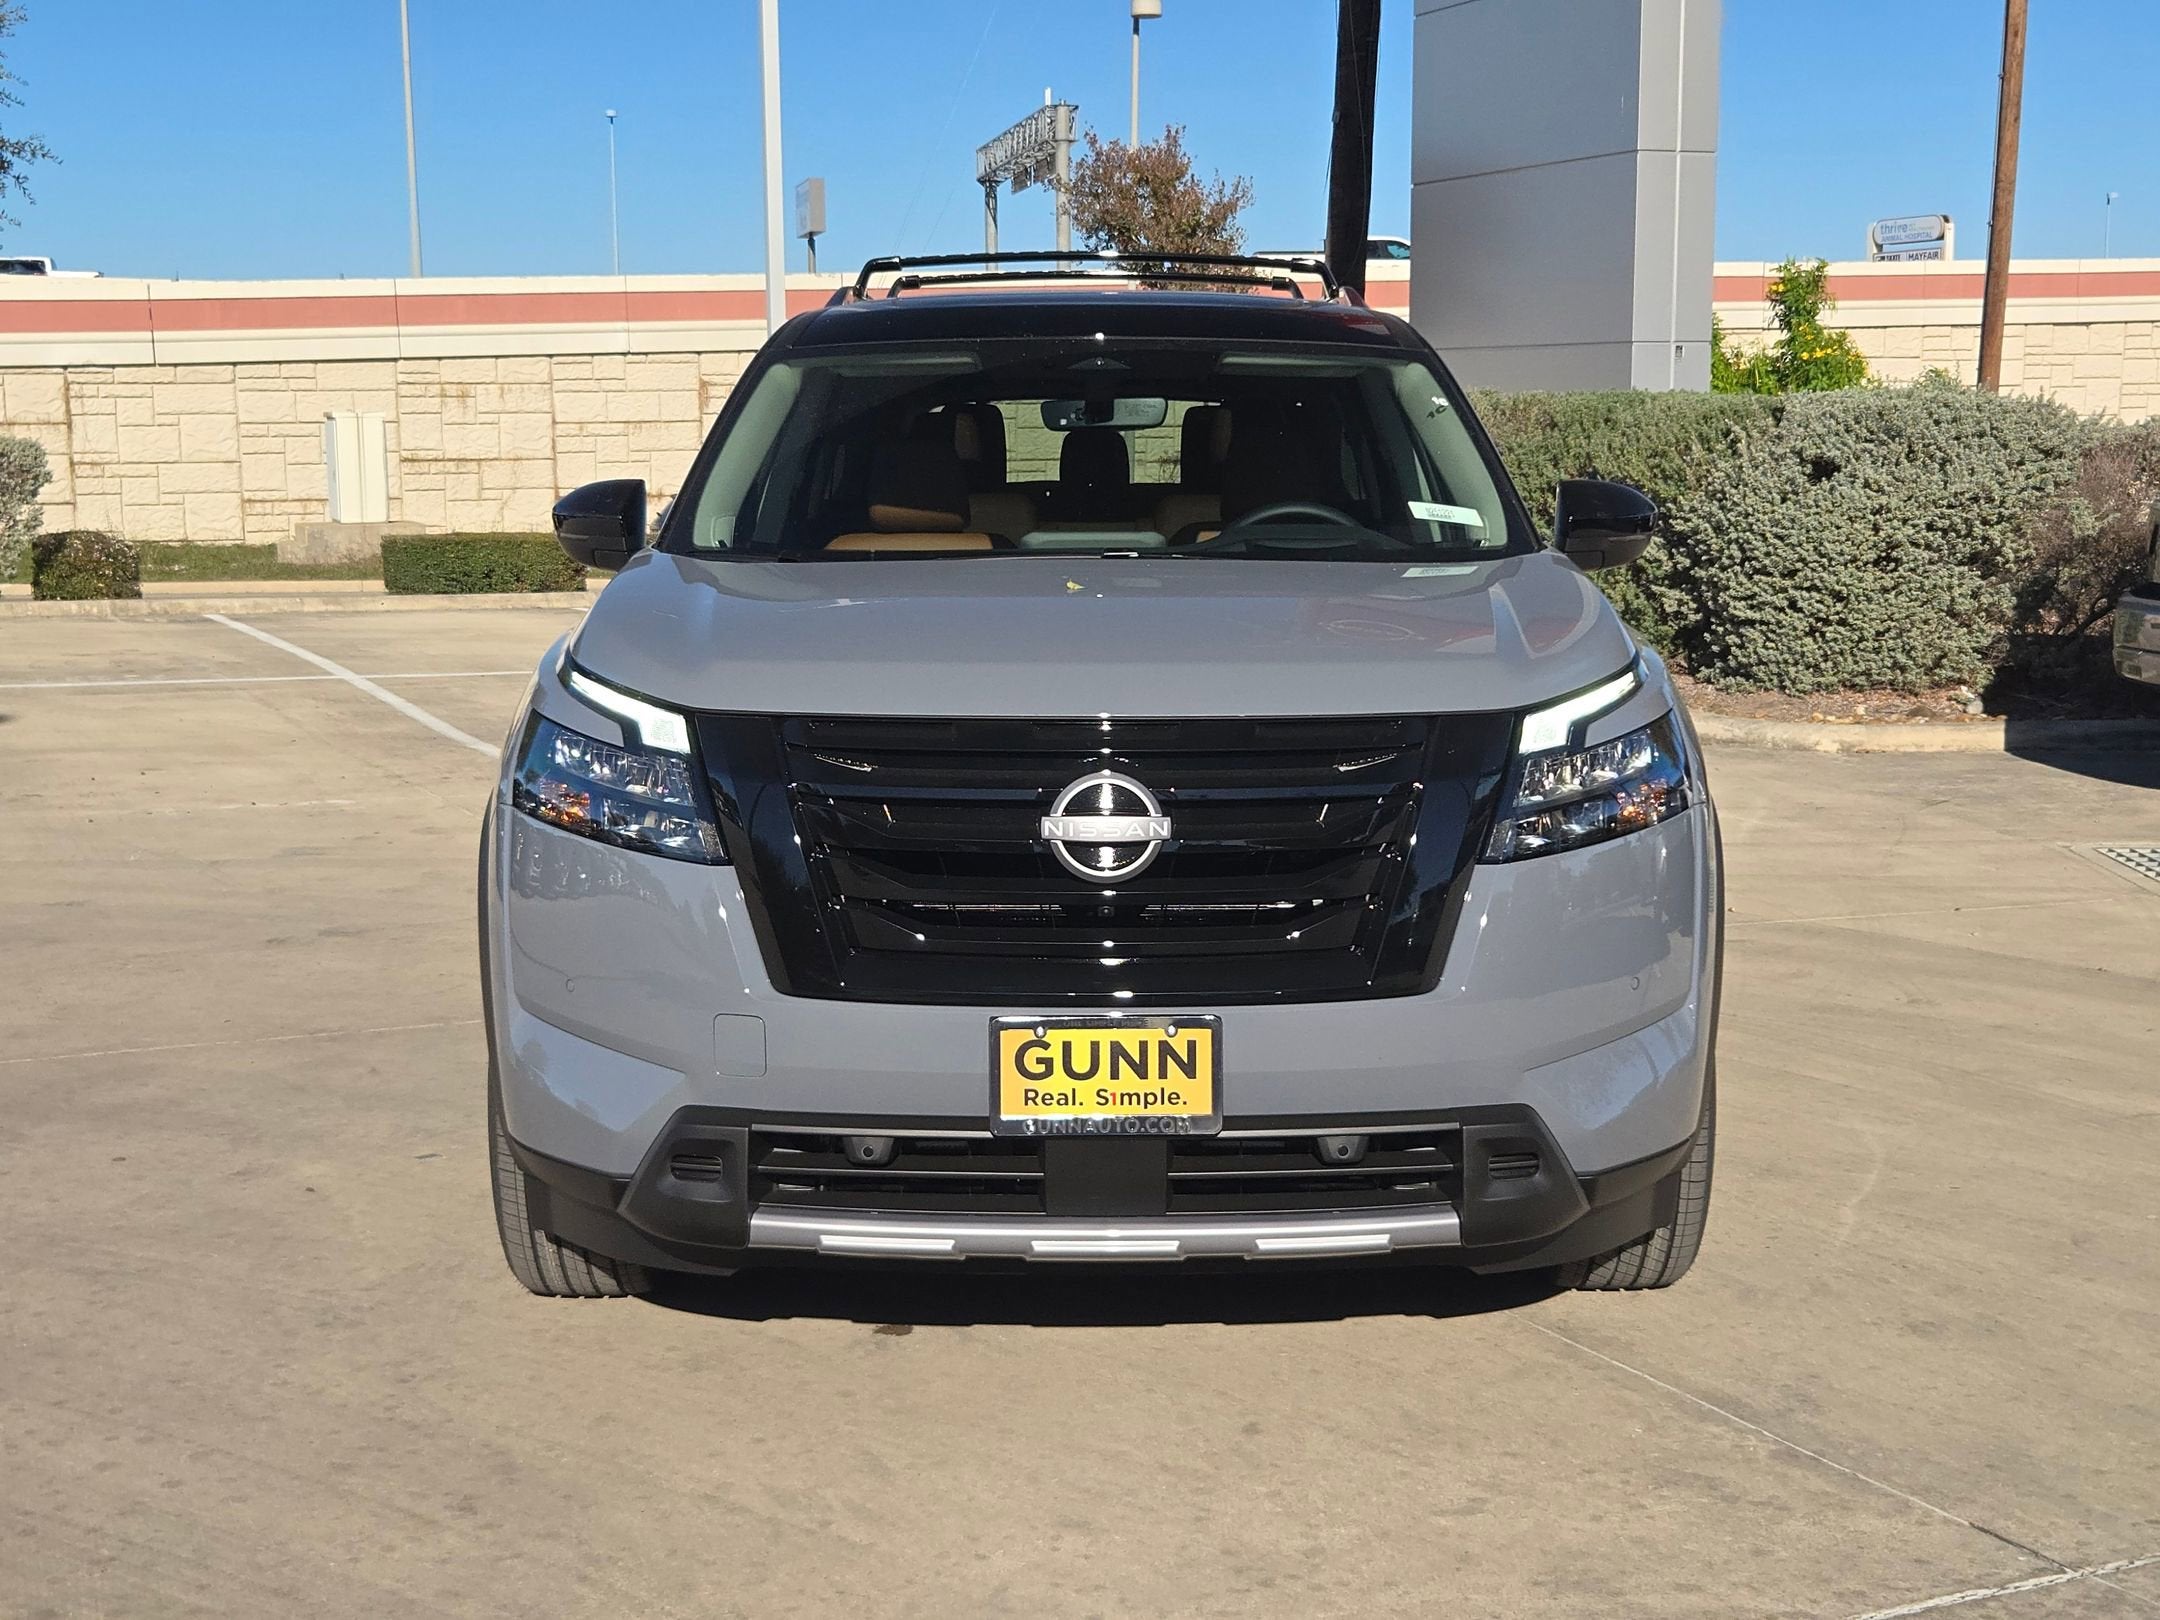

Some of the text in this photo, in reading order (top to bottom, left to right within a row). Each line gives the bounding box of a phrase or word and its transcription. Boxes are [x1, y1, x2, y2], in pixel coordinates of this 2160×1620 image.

[1903, 231, 1933, 241] HOSPITAL
[1908, 251, 1939, 261] MAYFAIR
[1043, 820, 1168, 837] NISSAN
[1014, 1040, 1197, 1081] GUNN
[1023, 1088, 1084, 1107] Real.
[1022, 1116, 1192, 1135] GUNNAUTO.COM
